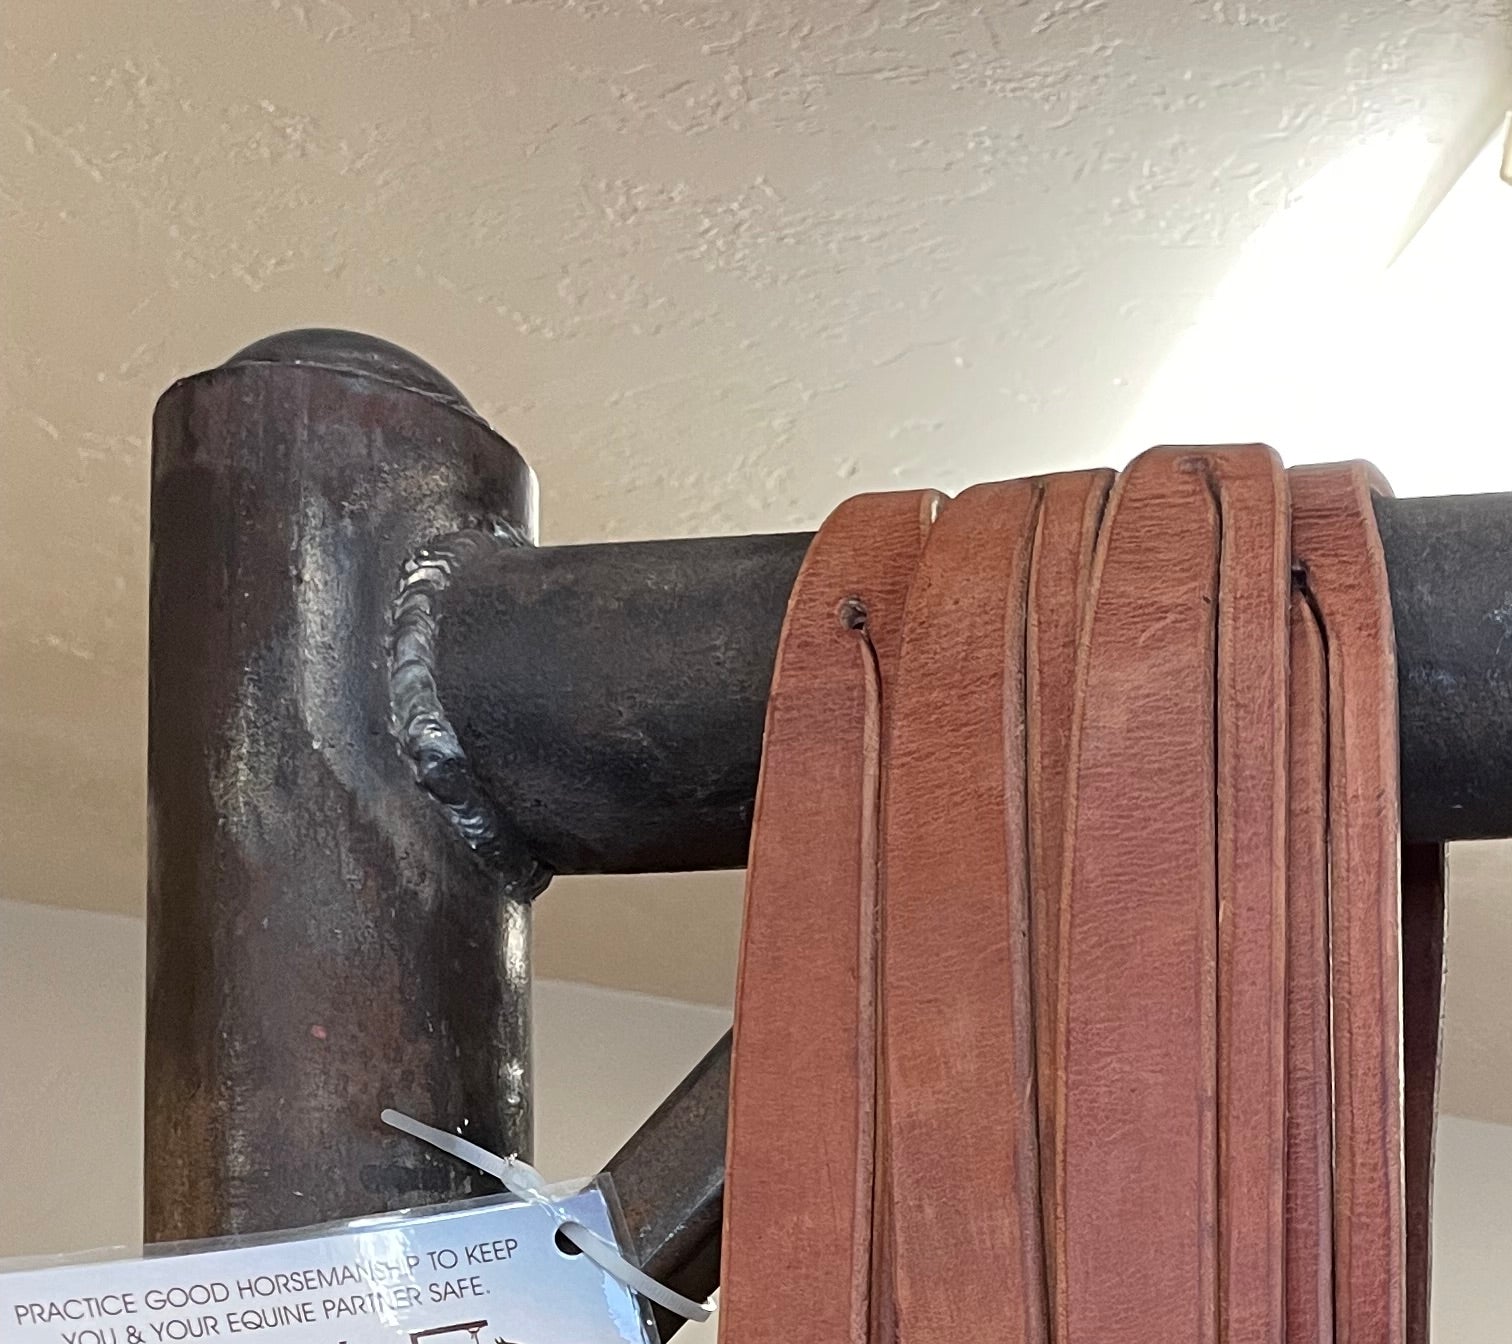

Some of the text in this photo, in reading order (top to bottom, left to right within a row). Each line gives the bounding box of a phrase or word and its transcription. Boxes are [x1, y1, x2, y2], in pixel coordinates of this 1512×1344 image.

[14, 1293, 138, 1326] PRACTICE
[144, 1283, 230, 1311] GOOD
[427, 1249, 458, 1270] TO
[465, 1238, 519, 1266] KEEP
[150, 1315, 220, 1343] YOUR
[226, 1302, 317, 1334] EQUINE
[322, 1287, 423, 1320] PARTNER
[429, 1276, 491, 1303] SAFE.
